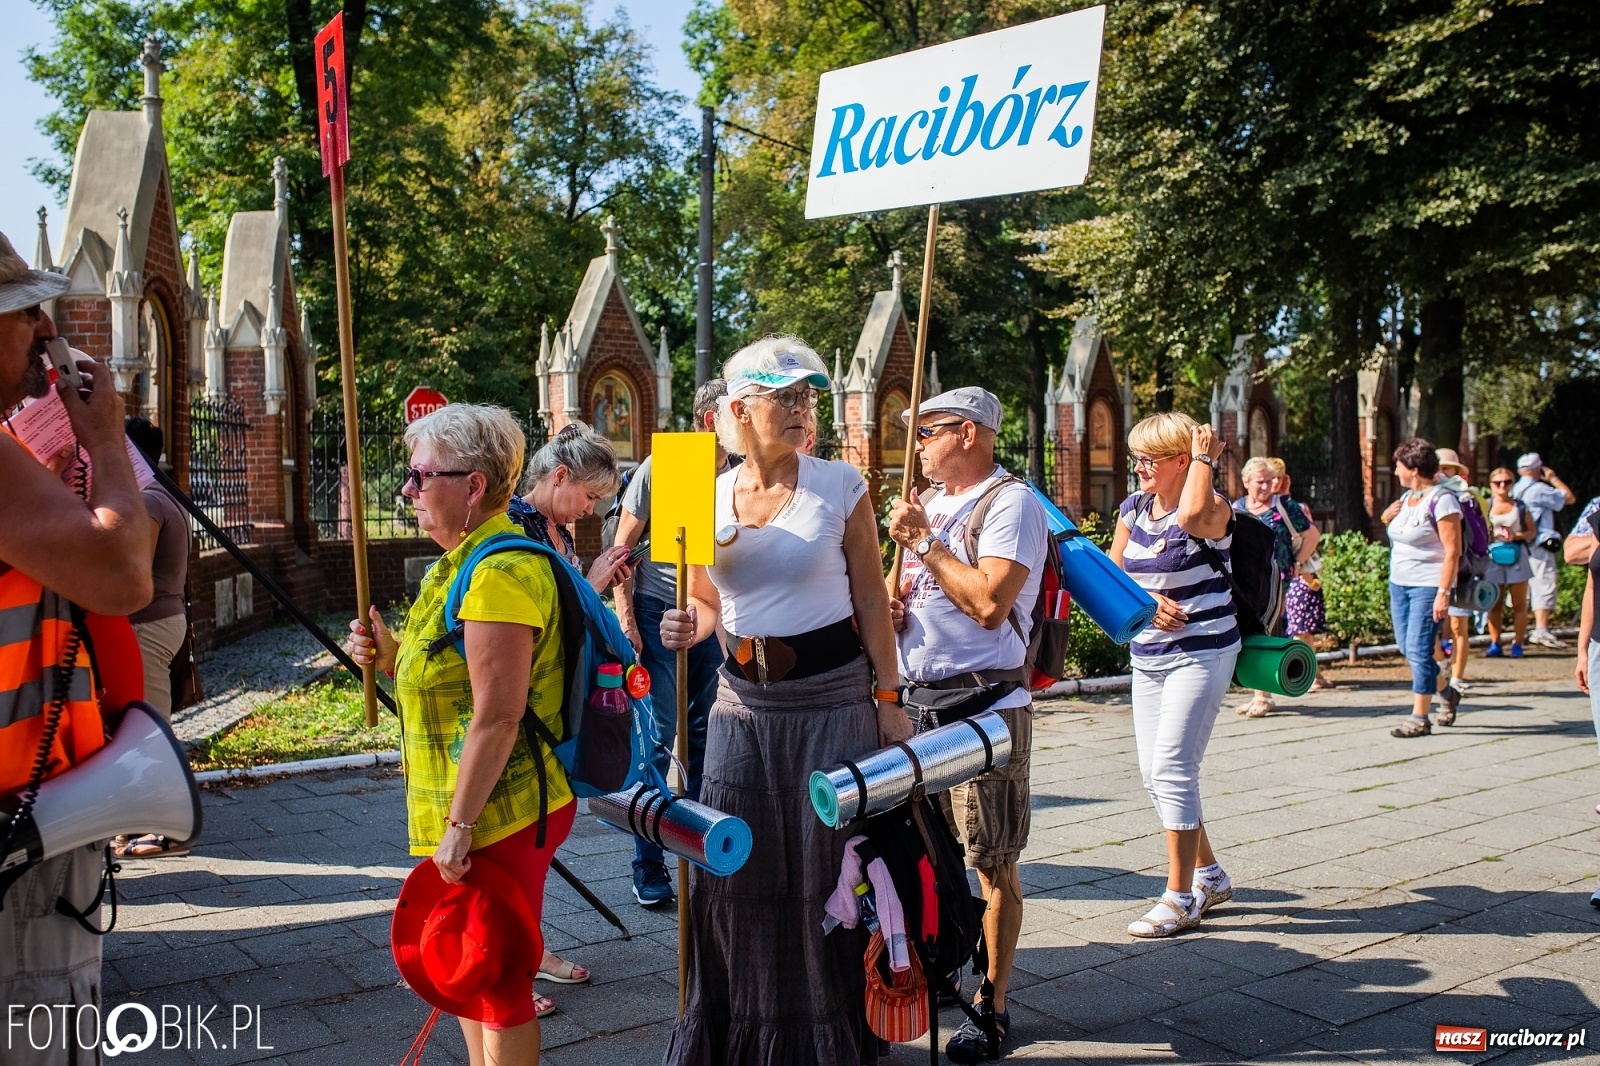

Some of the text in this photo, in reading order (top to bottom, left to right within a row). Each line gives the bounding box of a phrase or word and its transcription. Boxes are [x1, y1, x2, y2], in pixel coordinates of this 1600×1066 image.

[322, 36, 338, 124] 5
[816, 64, 1090, 179] Racibórz
[782, 502, 797, 520] ESPRIT
